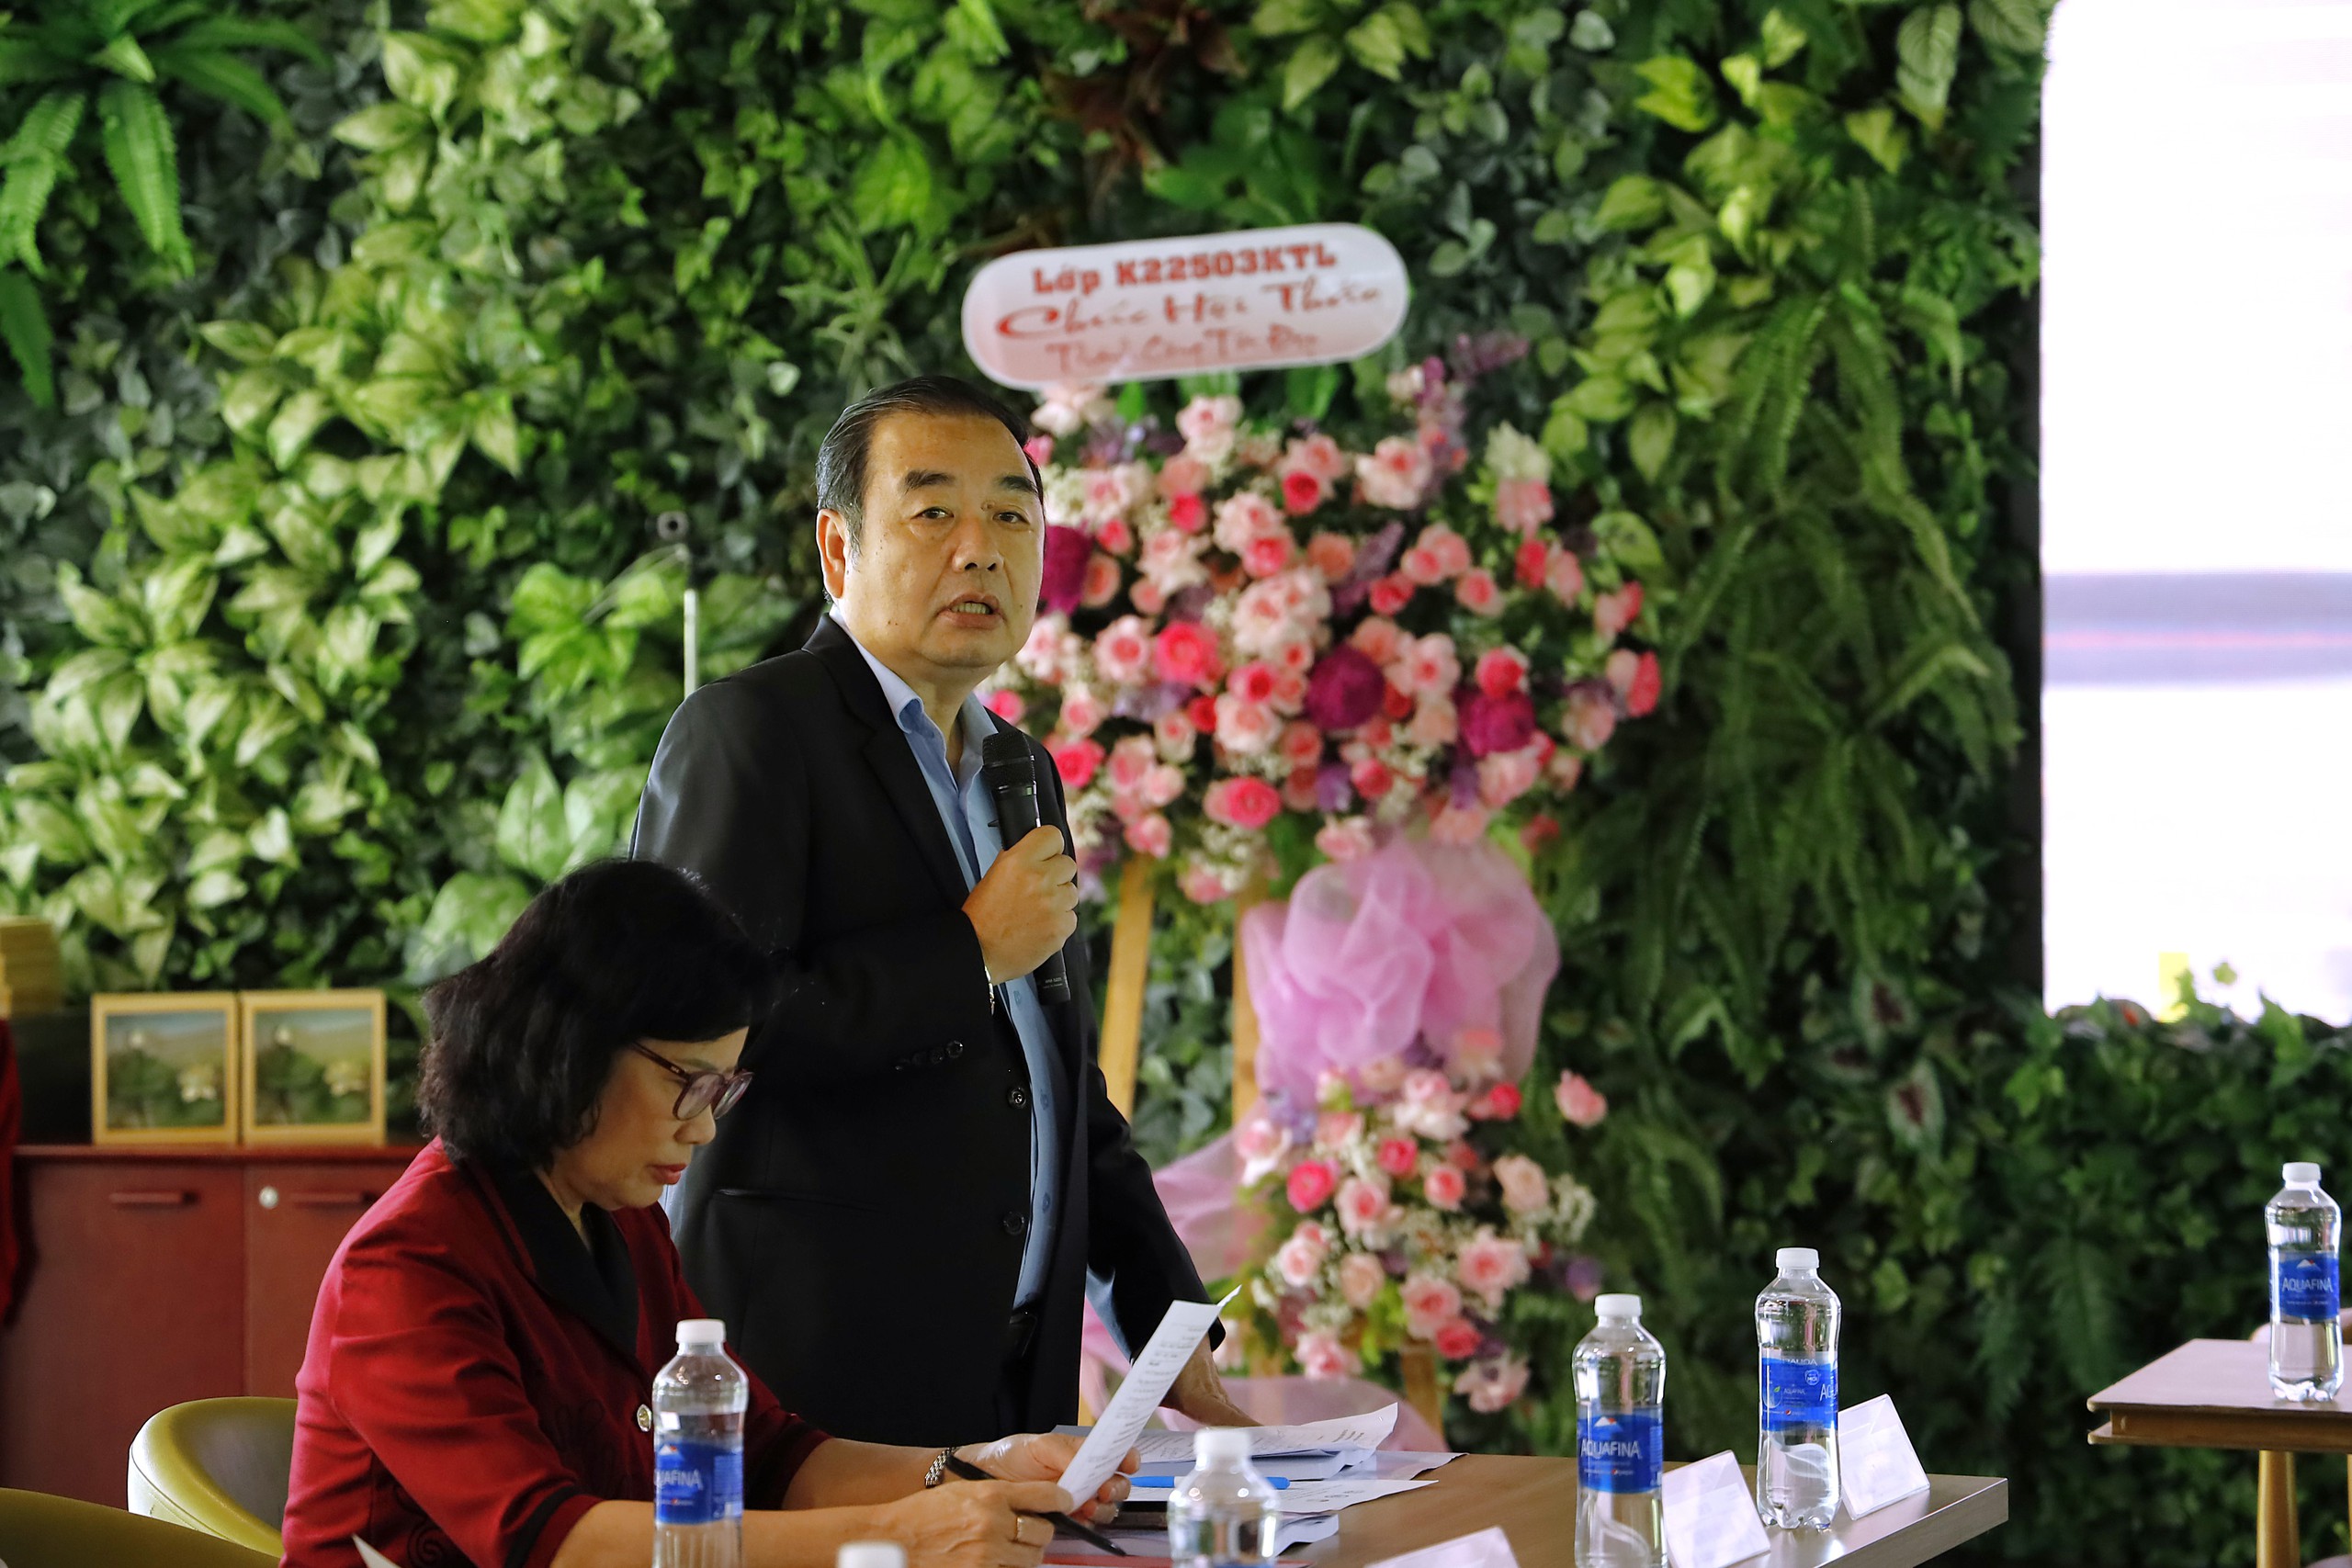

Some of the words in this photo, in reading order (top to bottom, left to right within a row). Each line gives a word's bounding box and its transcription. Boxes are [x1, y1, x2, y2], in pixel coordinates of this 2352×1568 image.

[1115, 243, 1337, 286] K22503KTL
[2281, 1277, 2334, 1293] AQUAFINA
[1580, 1438, 1643, 1460] AQUAFINA
